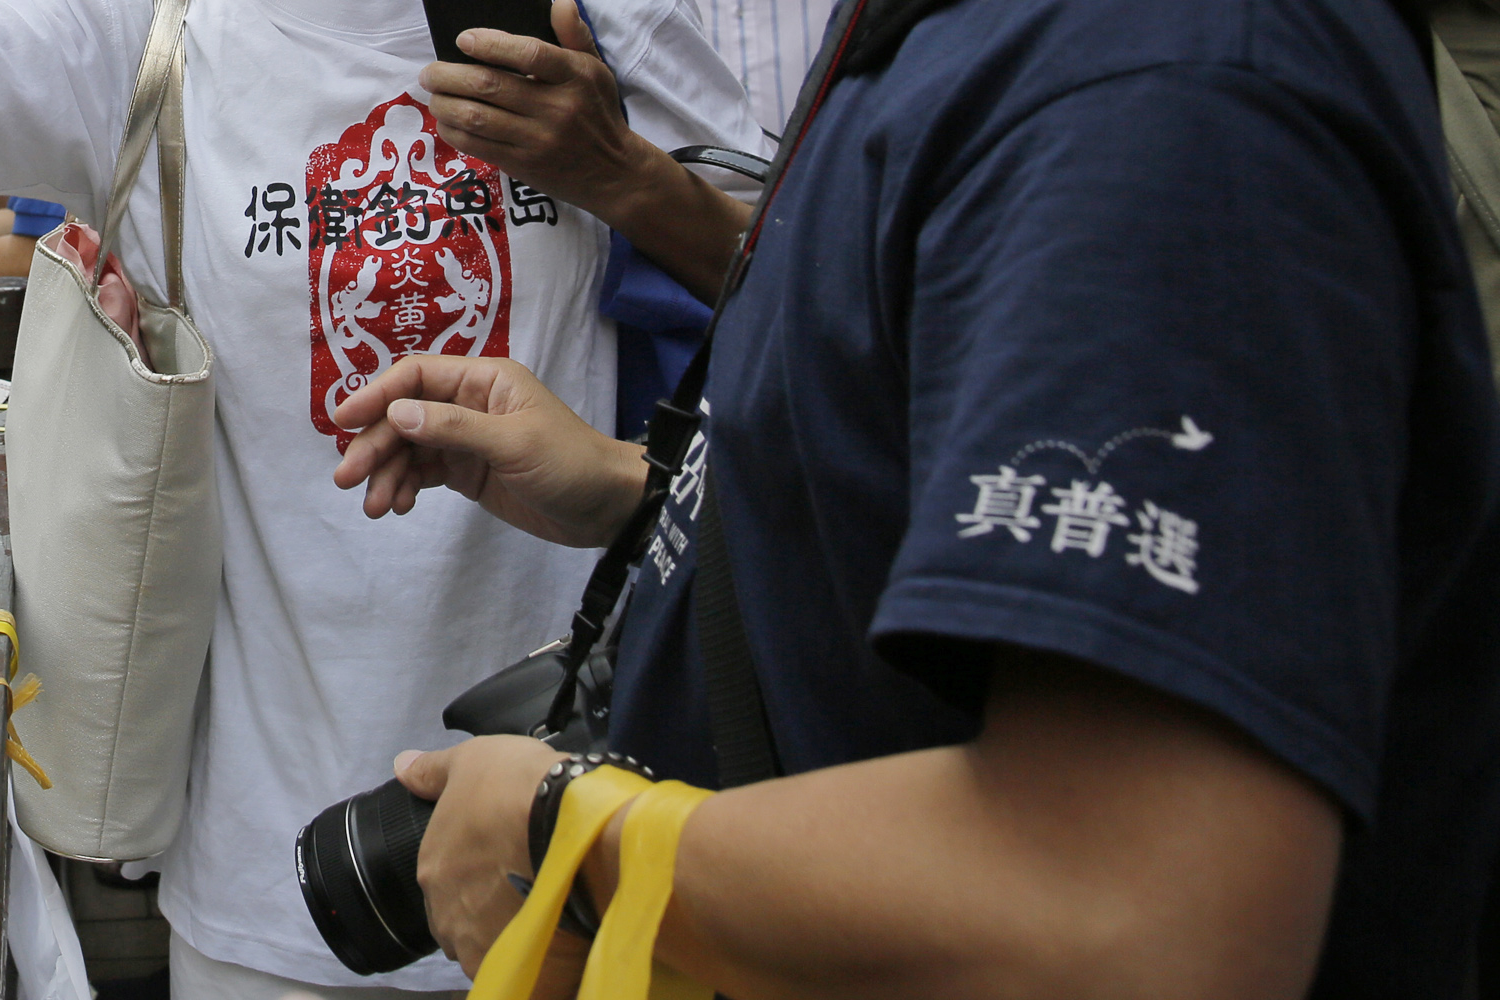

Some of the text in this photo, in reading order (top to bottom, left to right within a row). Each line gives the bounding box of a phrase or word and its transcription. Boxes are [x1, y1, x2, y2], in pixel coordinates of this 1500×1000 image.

[667, 522, 690, 556] WITH
[955, 464, 1199, 596] 真普選
[648, 534, 677, 586] PEACE
